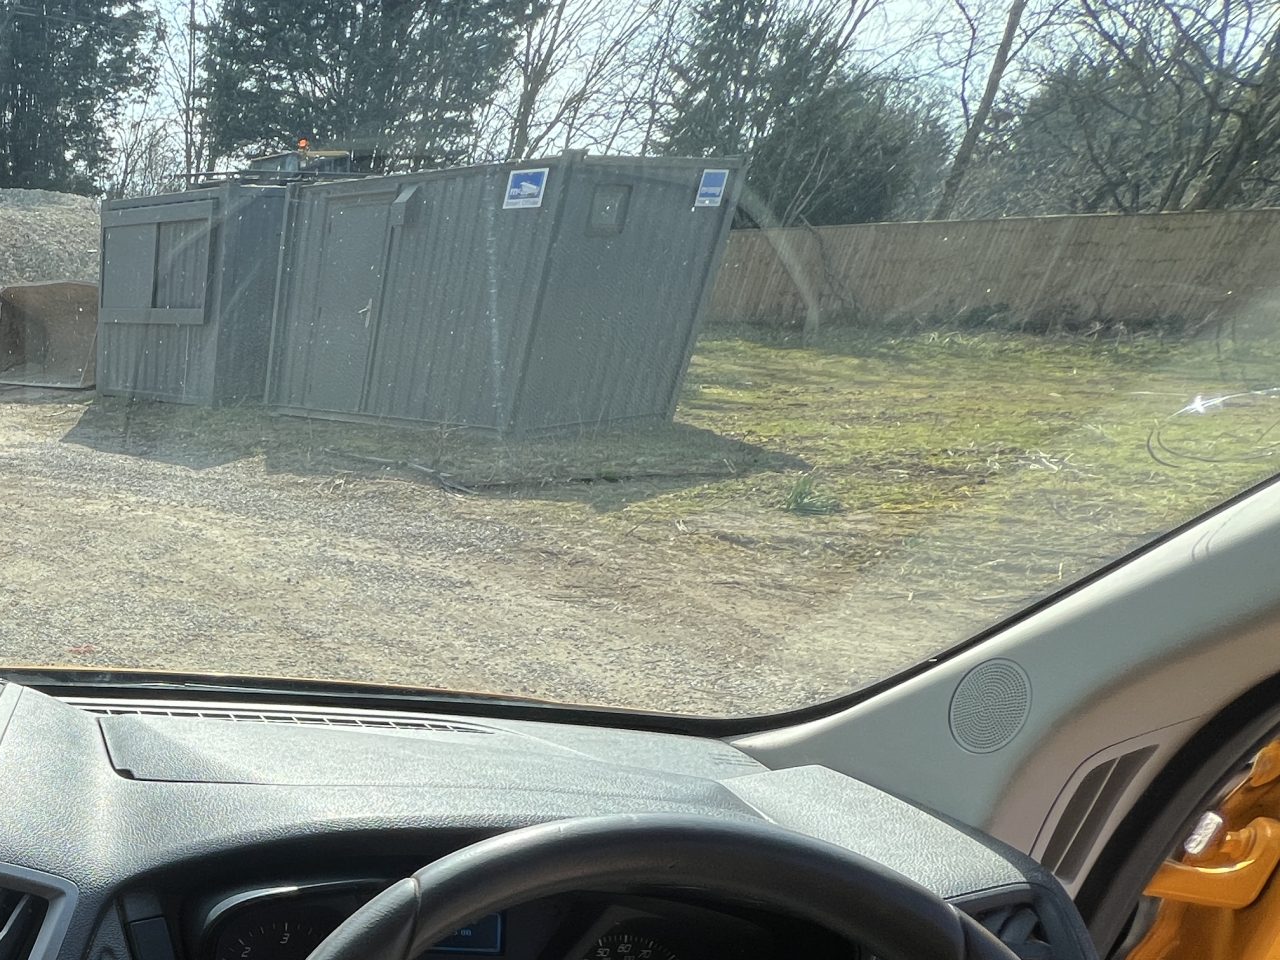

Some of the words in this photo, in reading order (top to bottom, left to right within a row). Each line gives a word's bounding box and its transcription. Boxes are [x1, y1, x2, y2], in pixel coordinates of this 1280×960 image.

[280, 933, 290, 944] 3
[241, 946, 251, 957] 2
[617, 943, 632, 953] 60
[638, 949, 652, 959] 70
